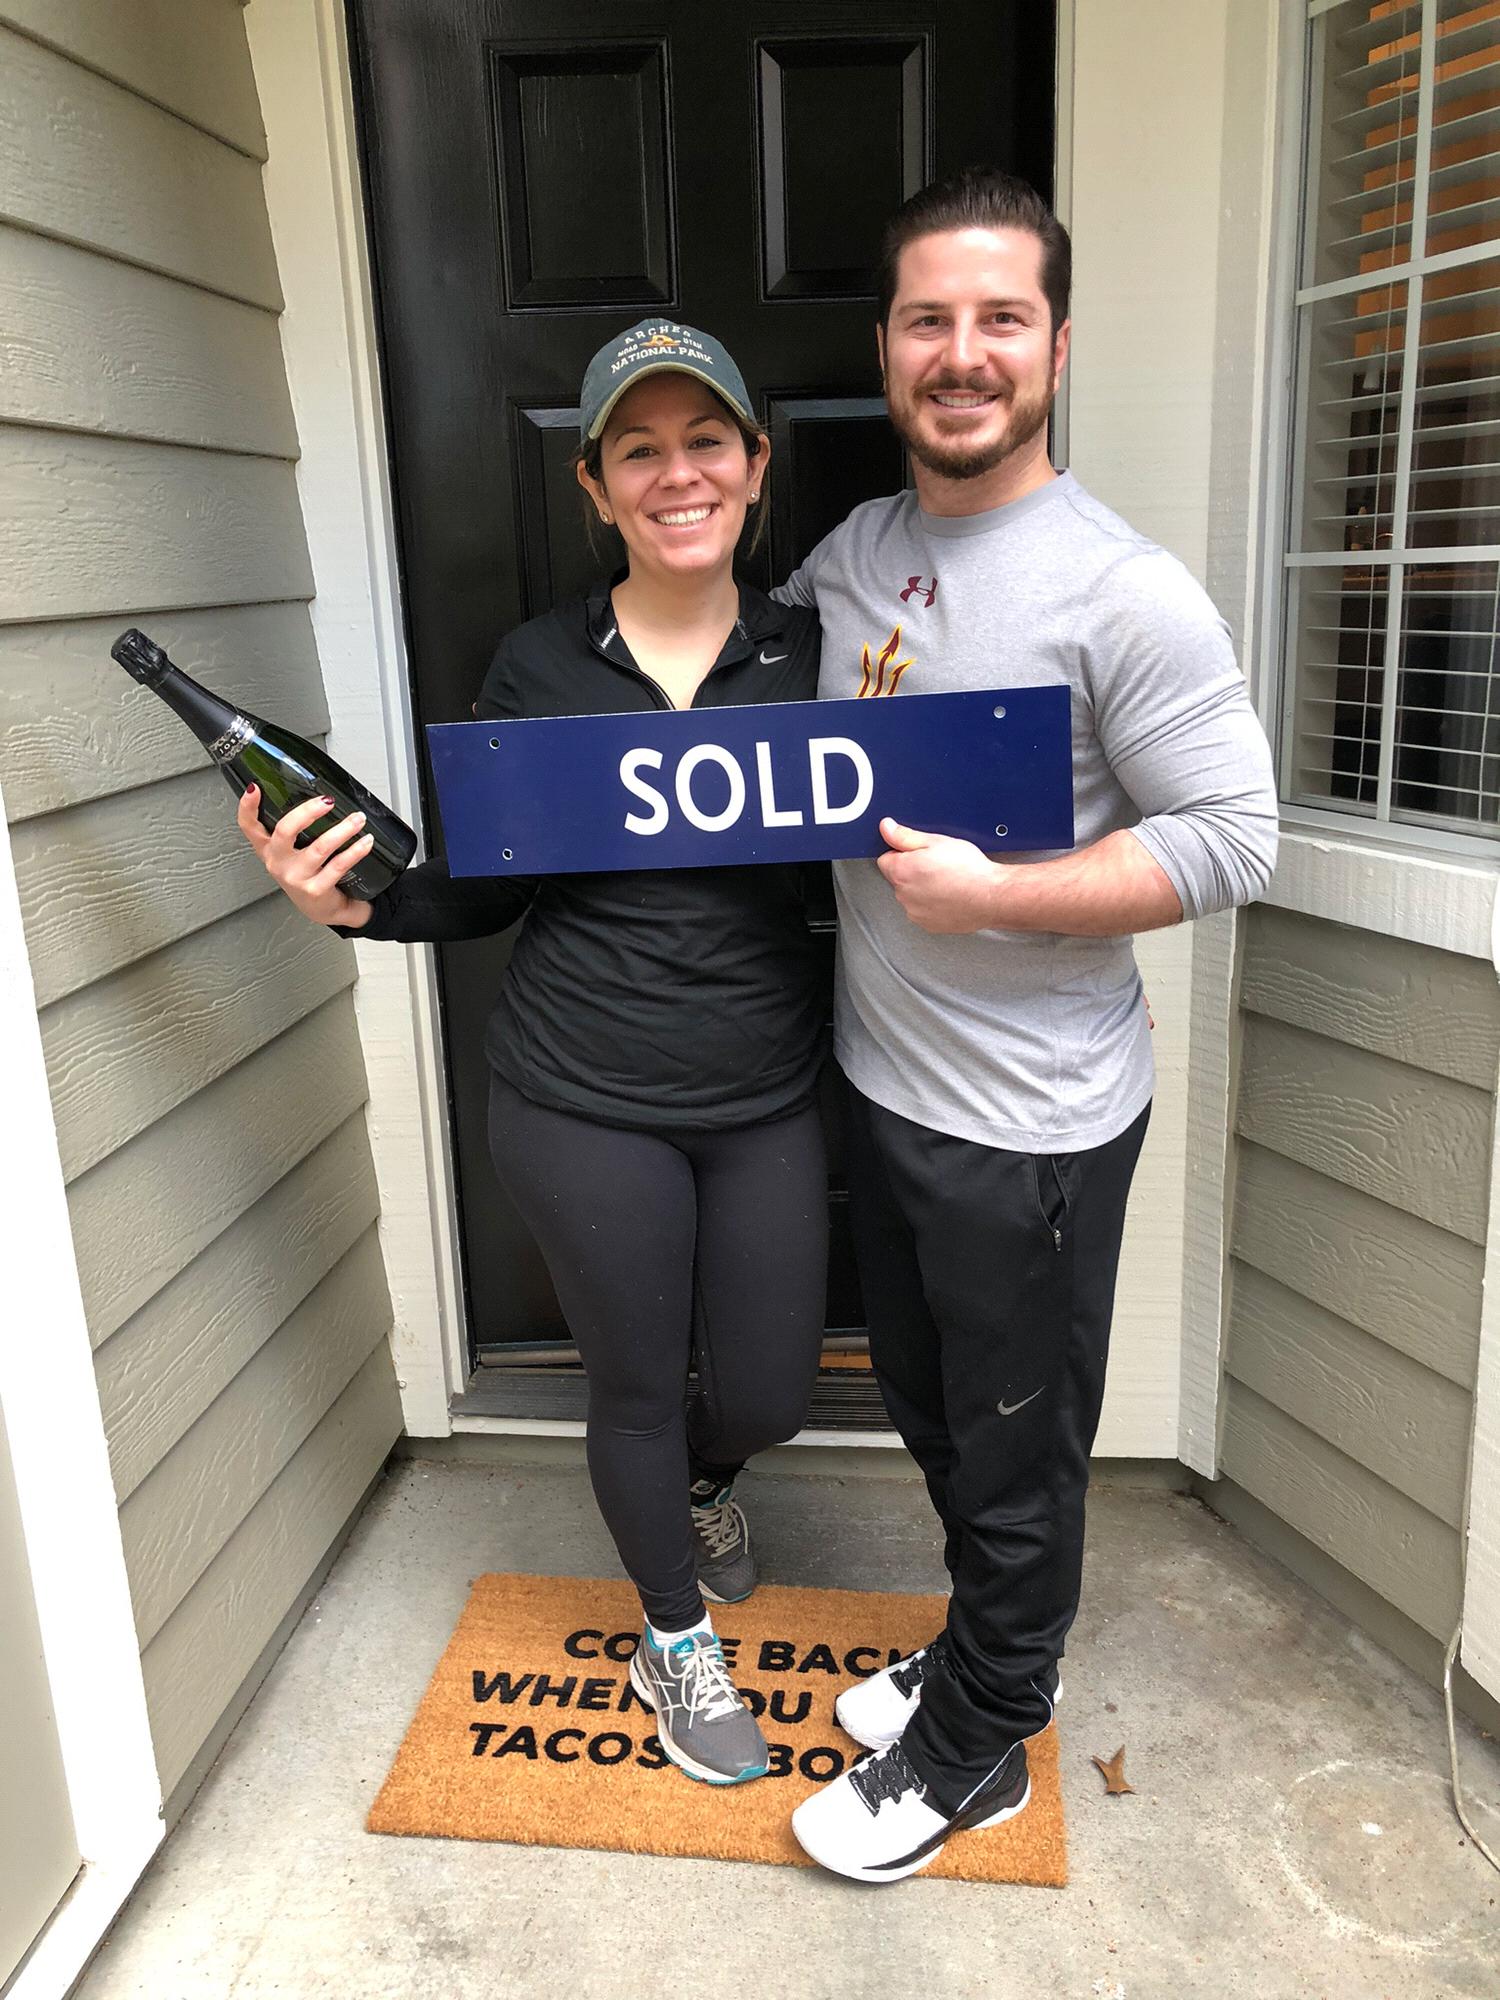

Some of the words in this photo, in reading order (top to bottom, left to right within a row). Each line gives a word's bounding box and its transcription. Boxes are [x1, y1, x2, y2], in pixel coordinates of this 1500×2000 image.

[611, 346, 676, 374] NATIONAL
[678, 346, 714, 365] PARK
[619, 737, 874, 836] SOLD
[564, 1629, 741, 1669] COE
[469, 1722, 671, 1769] TACOS
